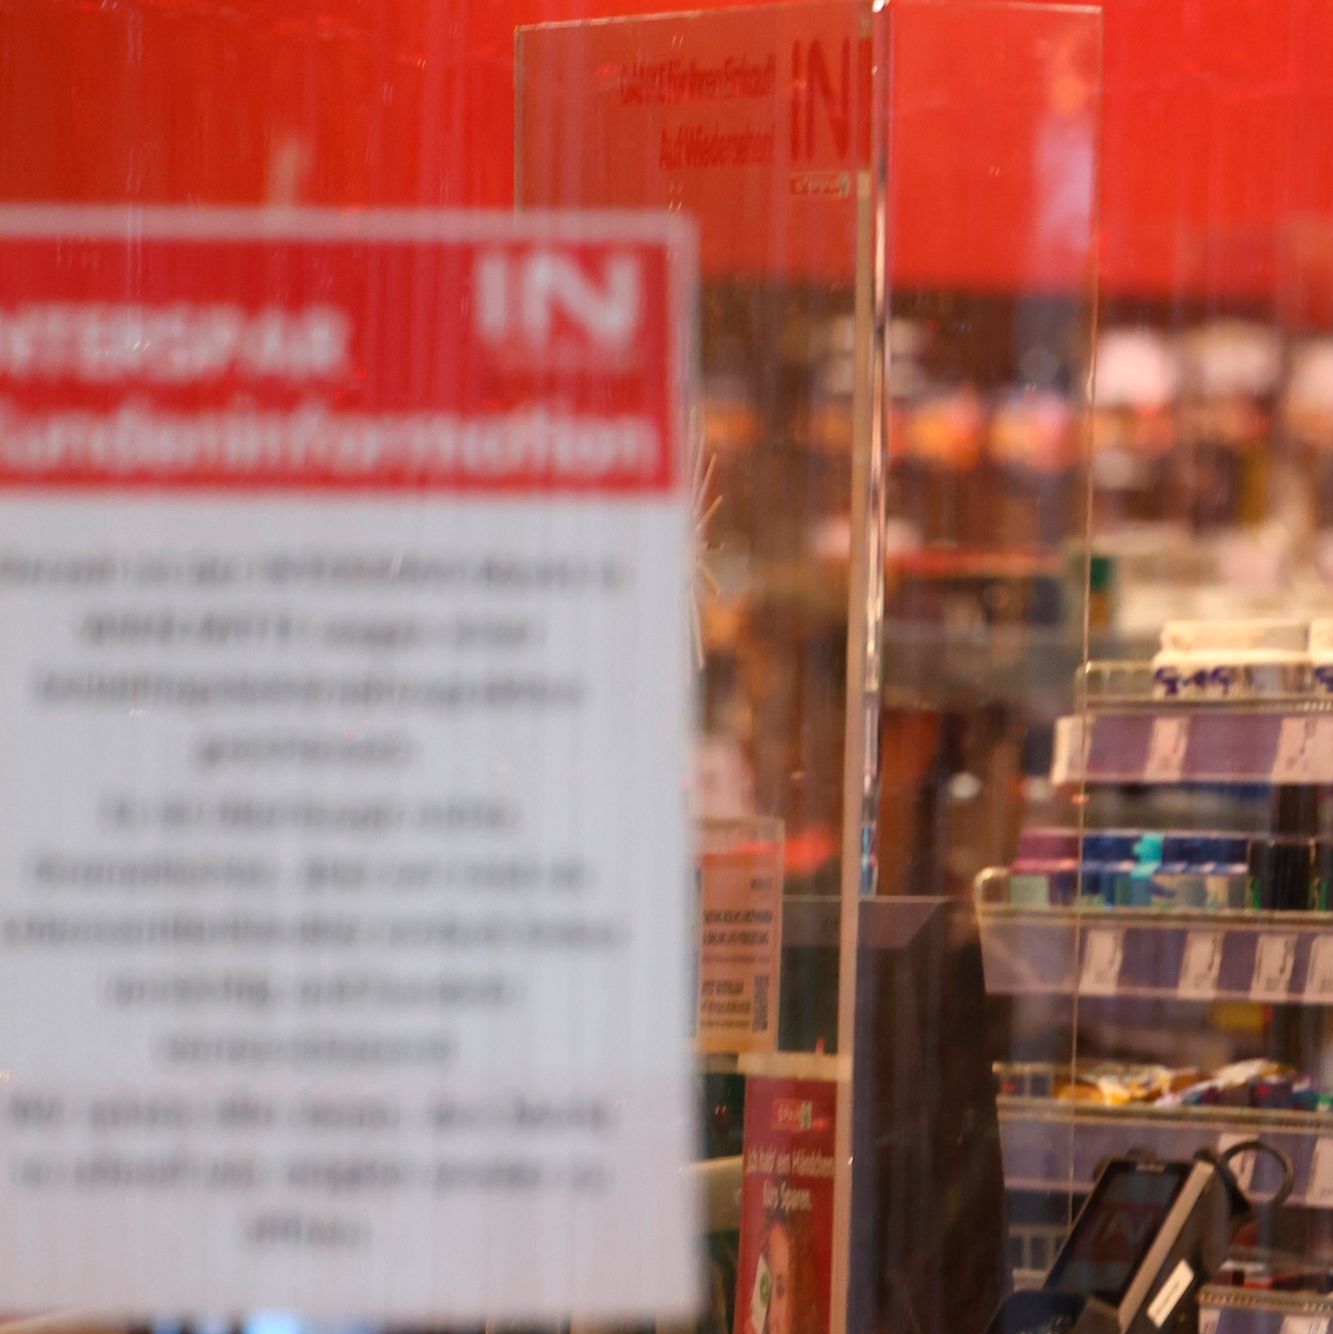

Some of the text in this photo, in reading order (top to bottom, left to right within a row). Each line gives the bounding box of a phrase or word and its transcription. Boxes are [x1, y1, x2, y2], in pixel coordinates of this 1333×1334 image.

[791, 39, 850, 162] IN
[0, 306, 350, 380] NTERSPAR
[473, 250, 640, 350] IN
[0, 400, 657, 471] undeninformation
